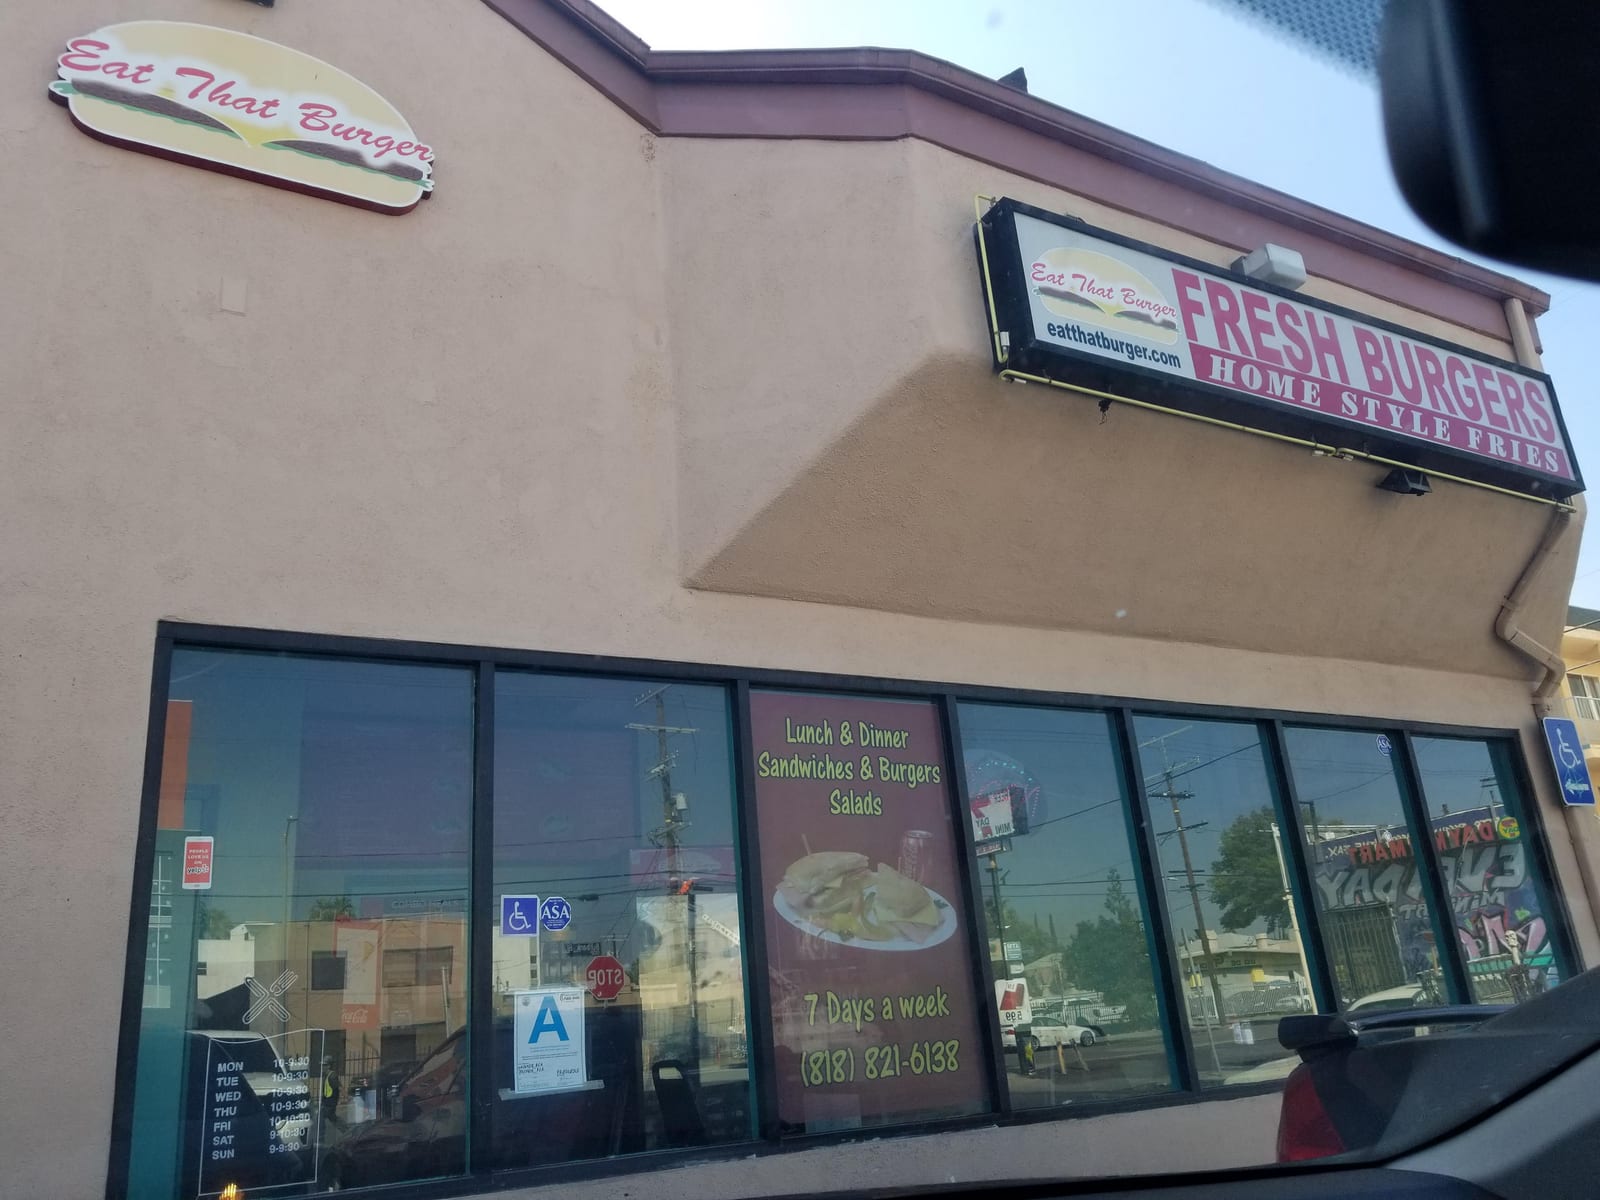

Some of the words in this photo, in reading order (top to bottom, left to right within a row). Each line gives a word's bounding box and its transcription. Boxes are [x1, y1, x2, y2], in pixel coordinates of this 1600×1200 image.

[61, 39, 156, 84] Eat
[175, 67, 281, 119] That
[298, 103, 433, 161] Burger
[1031, 262, 1067, 286] Eat
[1071, 273, 1114, 300] That
[1121, 287, 1177, 319] Burger
[1046, 319, 1181, 369] eatthatburger.com
[1171, 268, 1352, 386] FRESH
[1358, 331, 1557, 445] BURGERS
[1209, 353, 1321, 405] HOME
[1341, 390, 1451, 442] STYLE
[1467, 425, 1560, 473] FRIES
[785, 717, 834, 746] Lunch
[839, 721, 854, 746] &
[858, 720, 909, 748] Dinner
[758, 751, 854, 780] Sandwiches
[860, 755, 874, 781] &
[878, 756, 941, 789] Burgers
[829, 788, 882, 816] Salads
[541, 903, 570, 920] ASA
[528, 995, 570, 1044] A
[803, 993, 819, 1026] 7
[826, 991, 875, 1032] Days
[881, 997, 893, 1020] a
[899, 986, 949, 1019] week
[217, 1061, 244, 1073] MON
[801, 1047, 855, 1087] (818)
[864, 1039, 960, 1080] 821-6138
[216, 1076, 239, 1087] TUE
[272, 1071, 308, 1082] 10-9:30
[214, 1106, 237, 1117] THU
[270, 1100, 307, 1112] 10-9:30
[215, 1091, 241, 1102] WED
[212, 1135, 234, 1145] SAT
[213, 1121, 231, 1132] FRI
[212, 1149, 235, 1160] SUN
